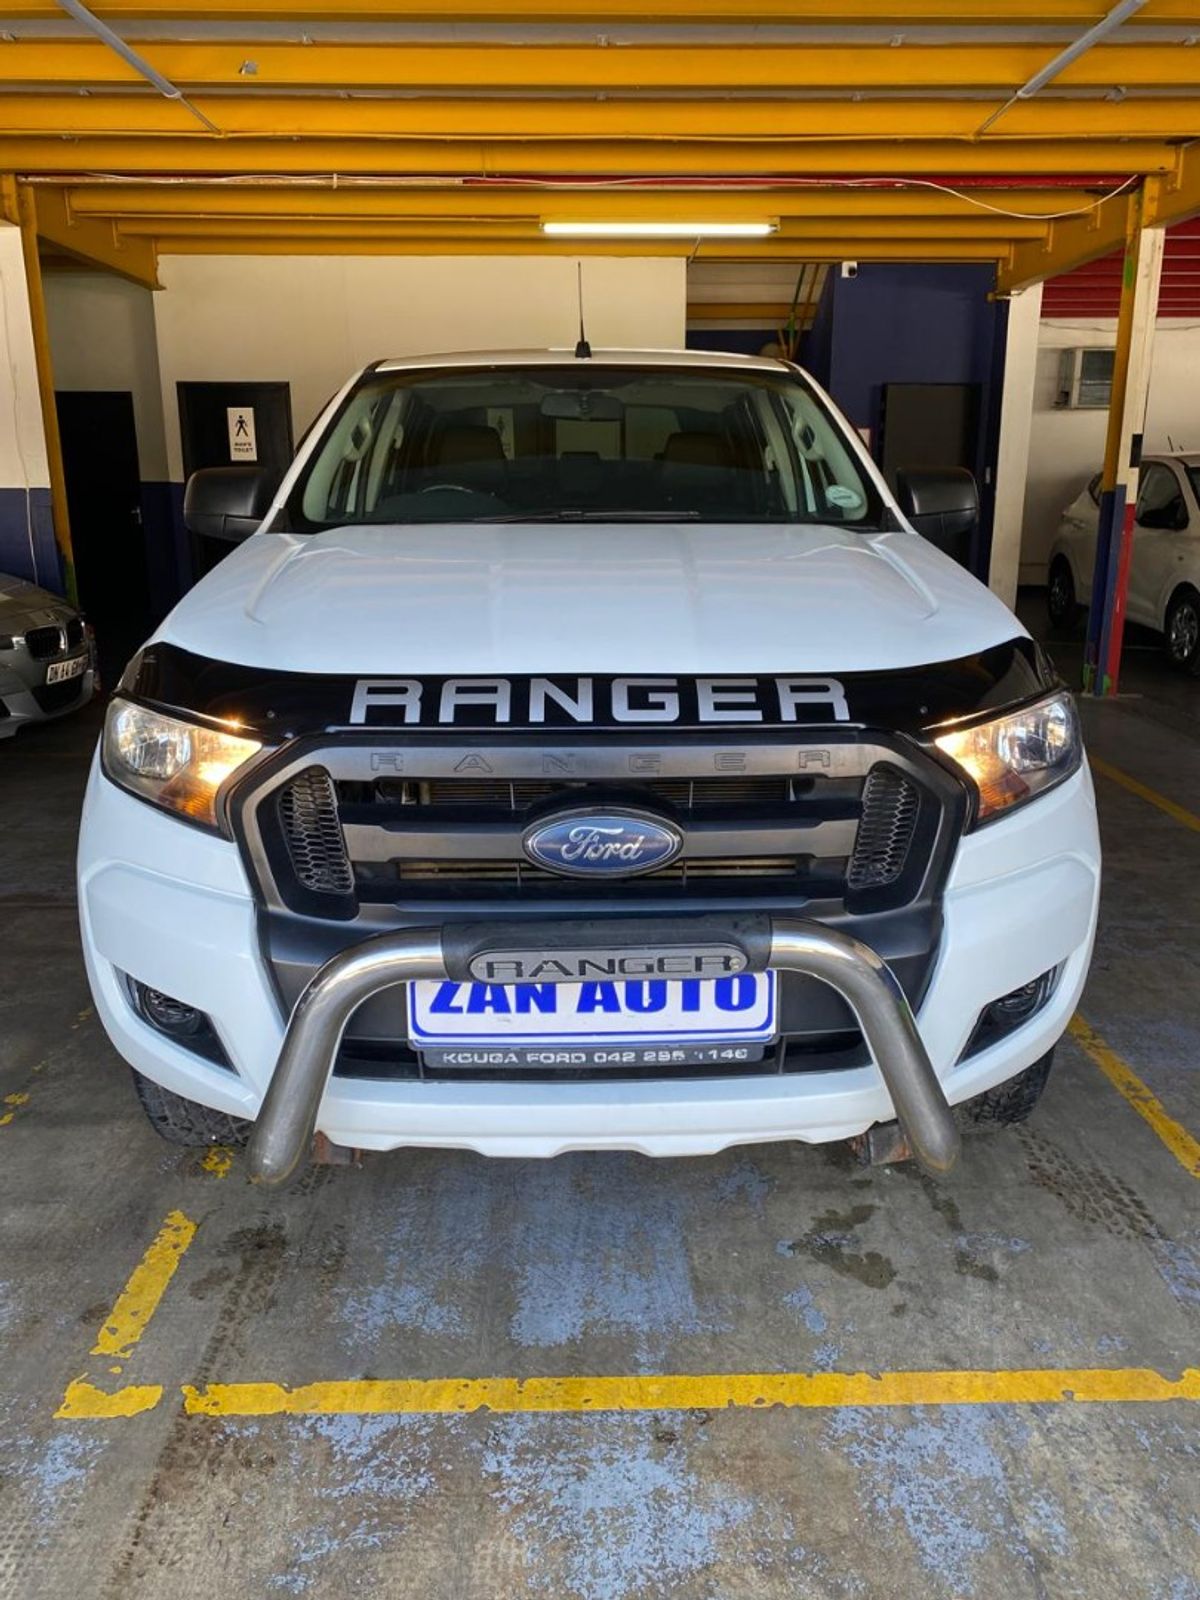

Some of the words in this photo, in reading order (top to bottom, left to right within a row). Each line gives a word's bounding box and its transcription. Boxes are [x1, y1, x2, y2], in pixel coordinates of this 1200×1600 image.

[349, 677, 850, 725] RANGER
[370, 749, 832, 774] RANGER
[561, 826, 645, 861] Ford
[486, 955, 732, 979] RANGER
[430, 979, 557, 1014] ZAN
[576, 973, 757, 1013] AUTO
[526, 1052, 587, 1064] FORD
[593, 1051, 637, 1063] 042
